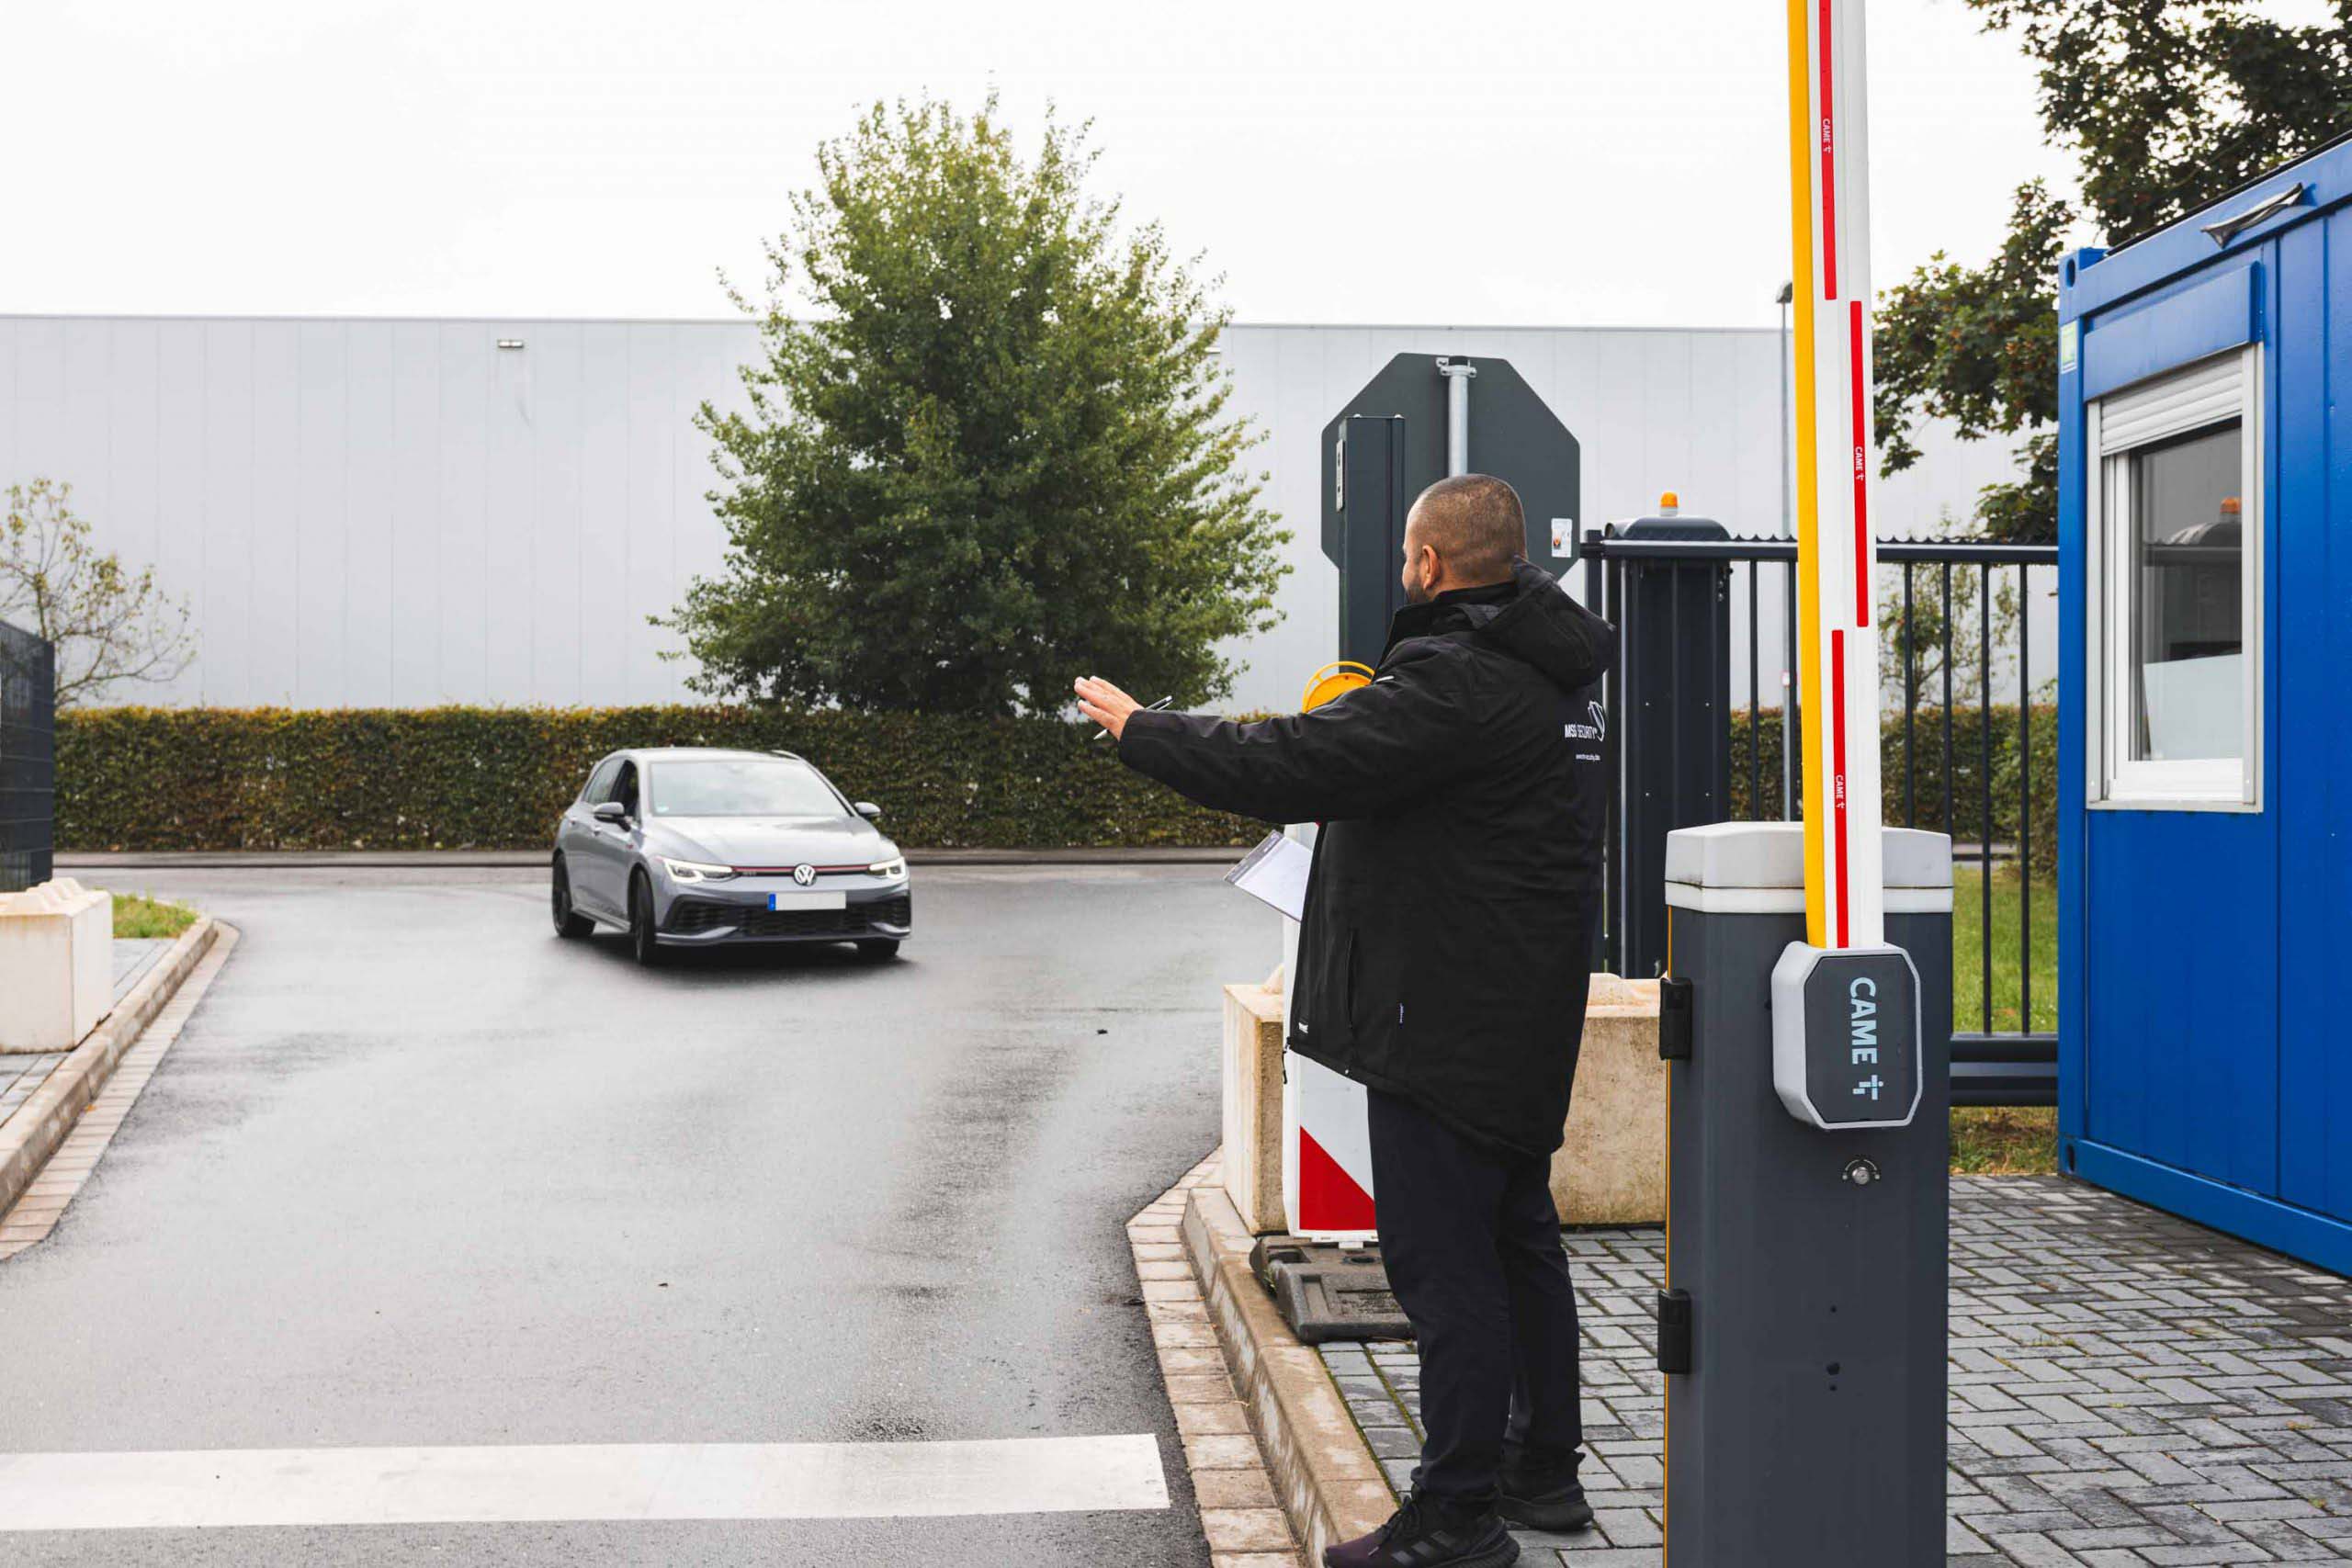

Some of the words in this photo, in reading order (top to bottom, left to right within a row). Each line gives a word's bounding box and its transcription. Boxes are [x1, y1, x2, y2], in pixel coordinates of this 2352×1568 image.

[1821, 118, 1831, 143] CAME
[1855, 446, 1864, 471] CAME
[1836, 774, 1844, 799] CAME
[1849, 976, 1879, 1066] CAME
